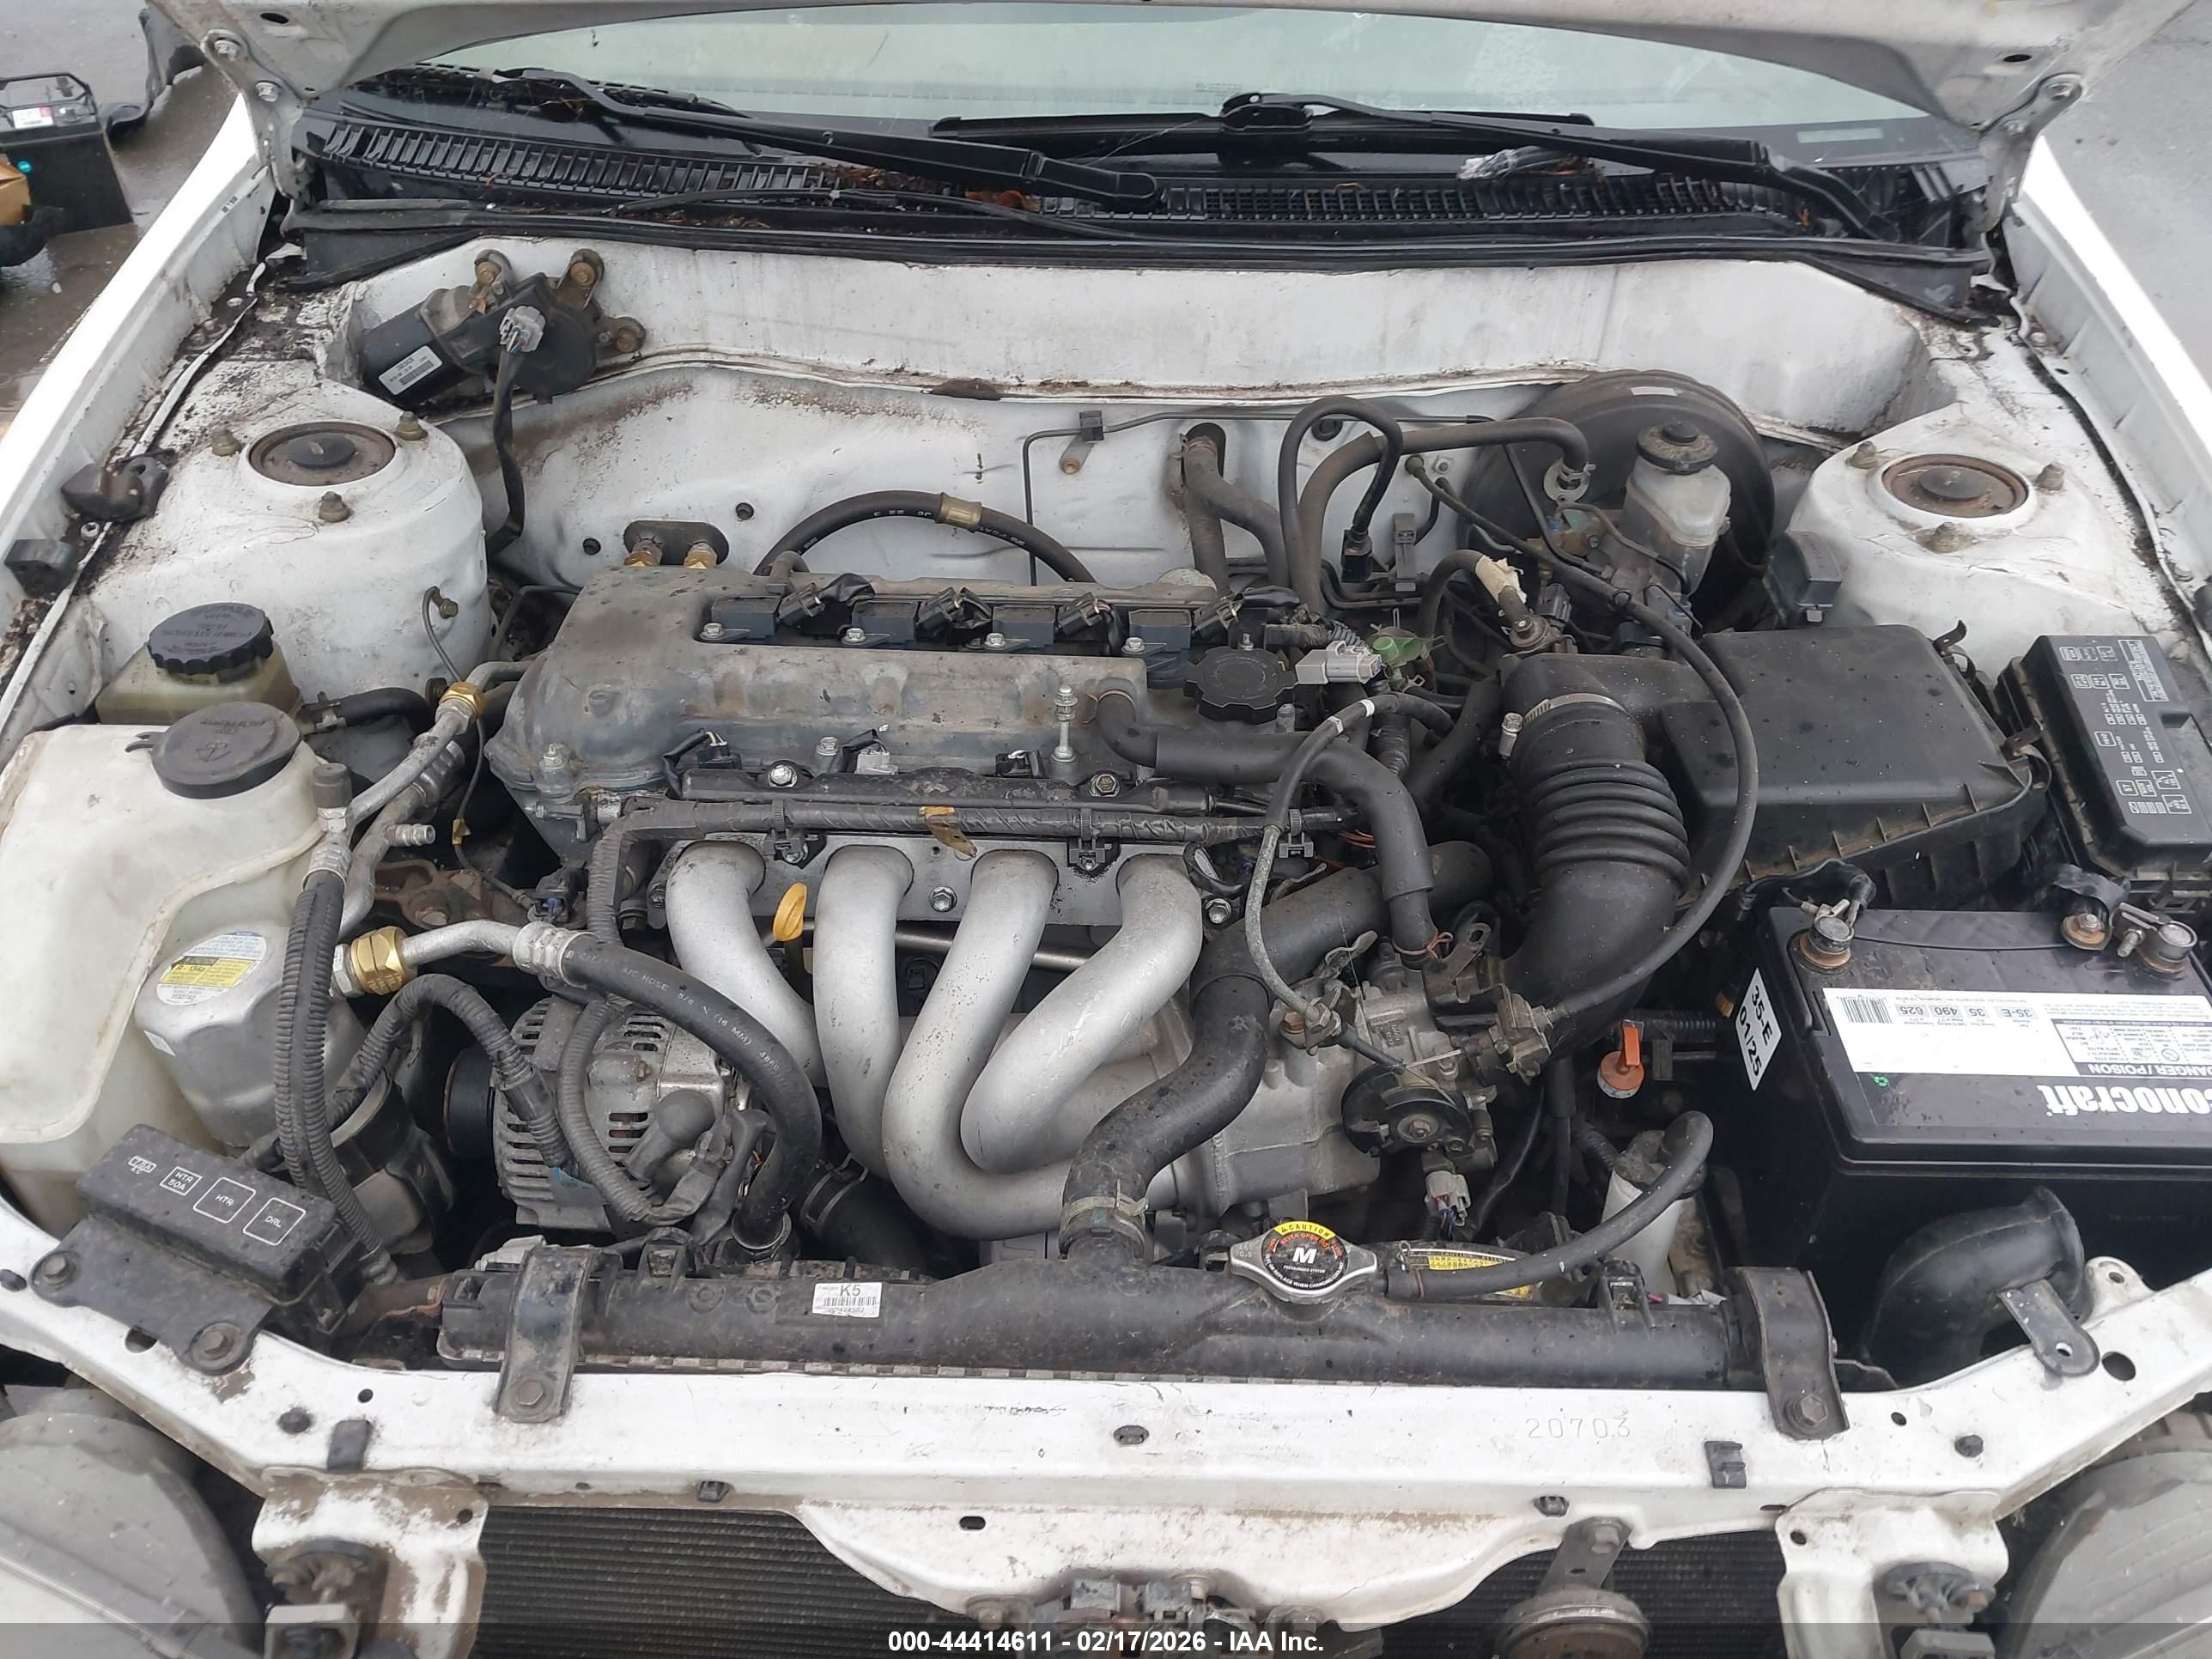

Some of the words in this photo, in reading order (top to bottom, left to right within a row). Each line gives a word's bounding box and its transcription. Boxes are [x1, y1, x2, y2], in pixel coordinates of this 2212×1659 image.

[2100, 733, 2111, 745] HEAD
[2124, 783, 2134, 792] ST
[622, 966, 637, 978] A/C
[641, 975, 669, 991] HOSE
[678, 993, 694, 1006] 5/8
[731, 1027, 752, 1046] MM)
[1899, 1006, 1924, 1015] 625
[1934, 1006, 1958, 1016] 490
[1969, 1008, 1985, 1017] 35
[1751, 985, 1773, 1046] 35-E
[2001, 1008, 2033, 1018] 35-E
[1739, 1006, 1762, 1076] 01/25
[174, 1171, 193, 1183] HTR
[167, 1178, 186, 1191] 50A
[215, 1194, 234, 1206] HTR
[264, 1215, 282, 1228] DRL
[1289, 1224, 1332, 1237] CAUTION
[1279, 1232, 1299, 1245] NEVER
[1301, 1233, 1319, 1242] OPEN
[1292, 1247, 1317, 1264] M
[1273, 1268, 1293, 1285] REPLACE
[840, 1284, 860, 1297] K5
[1525, 1414, 1630, 1438] 20703
